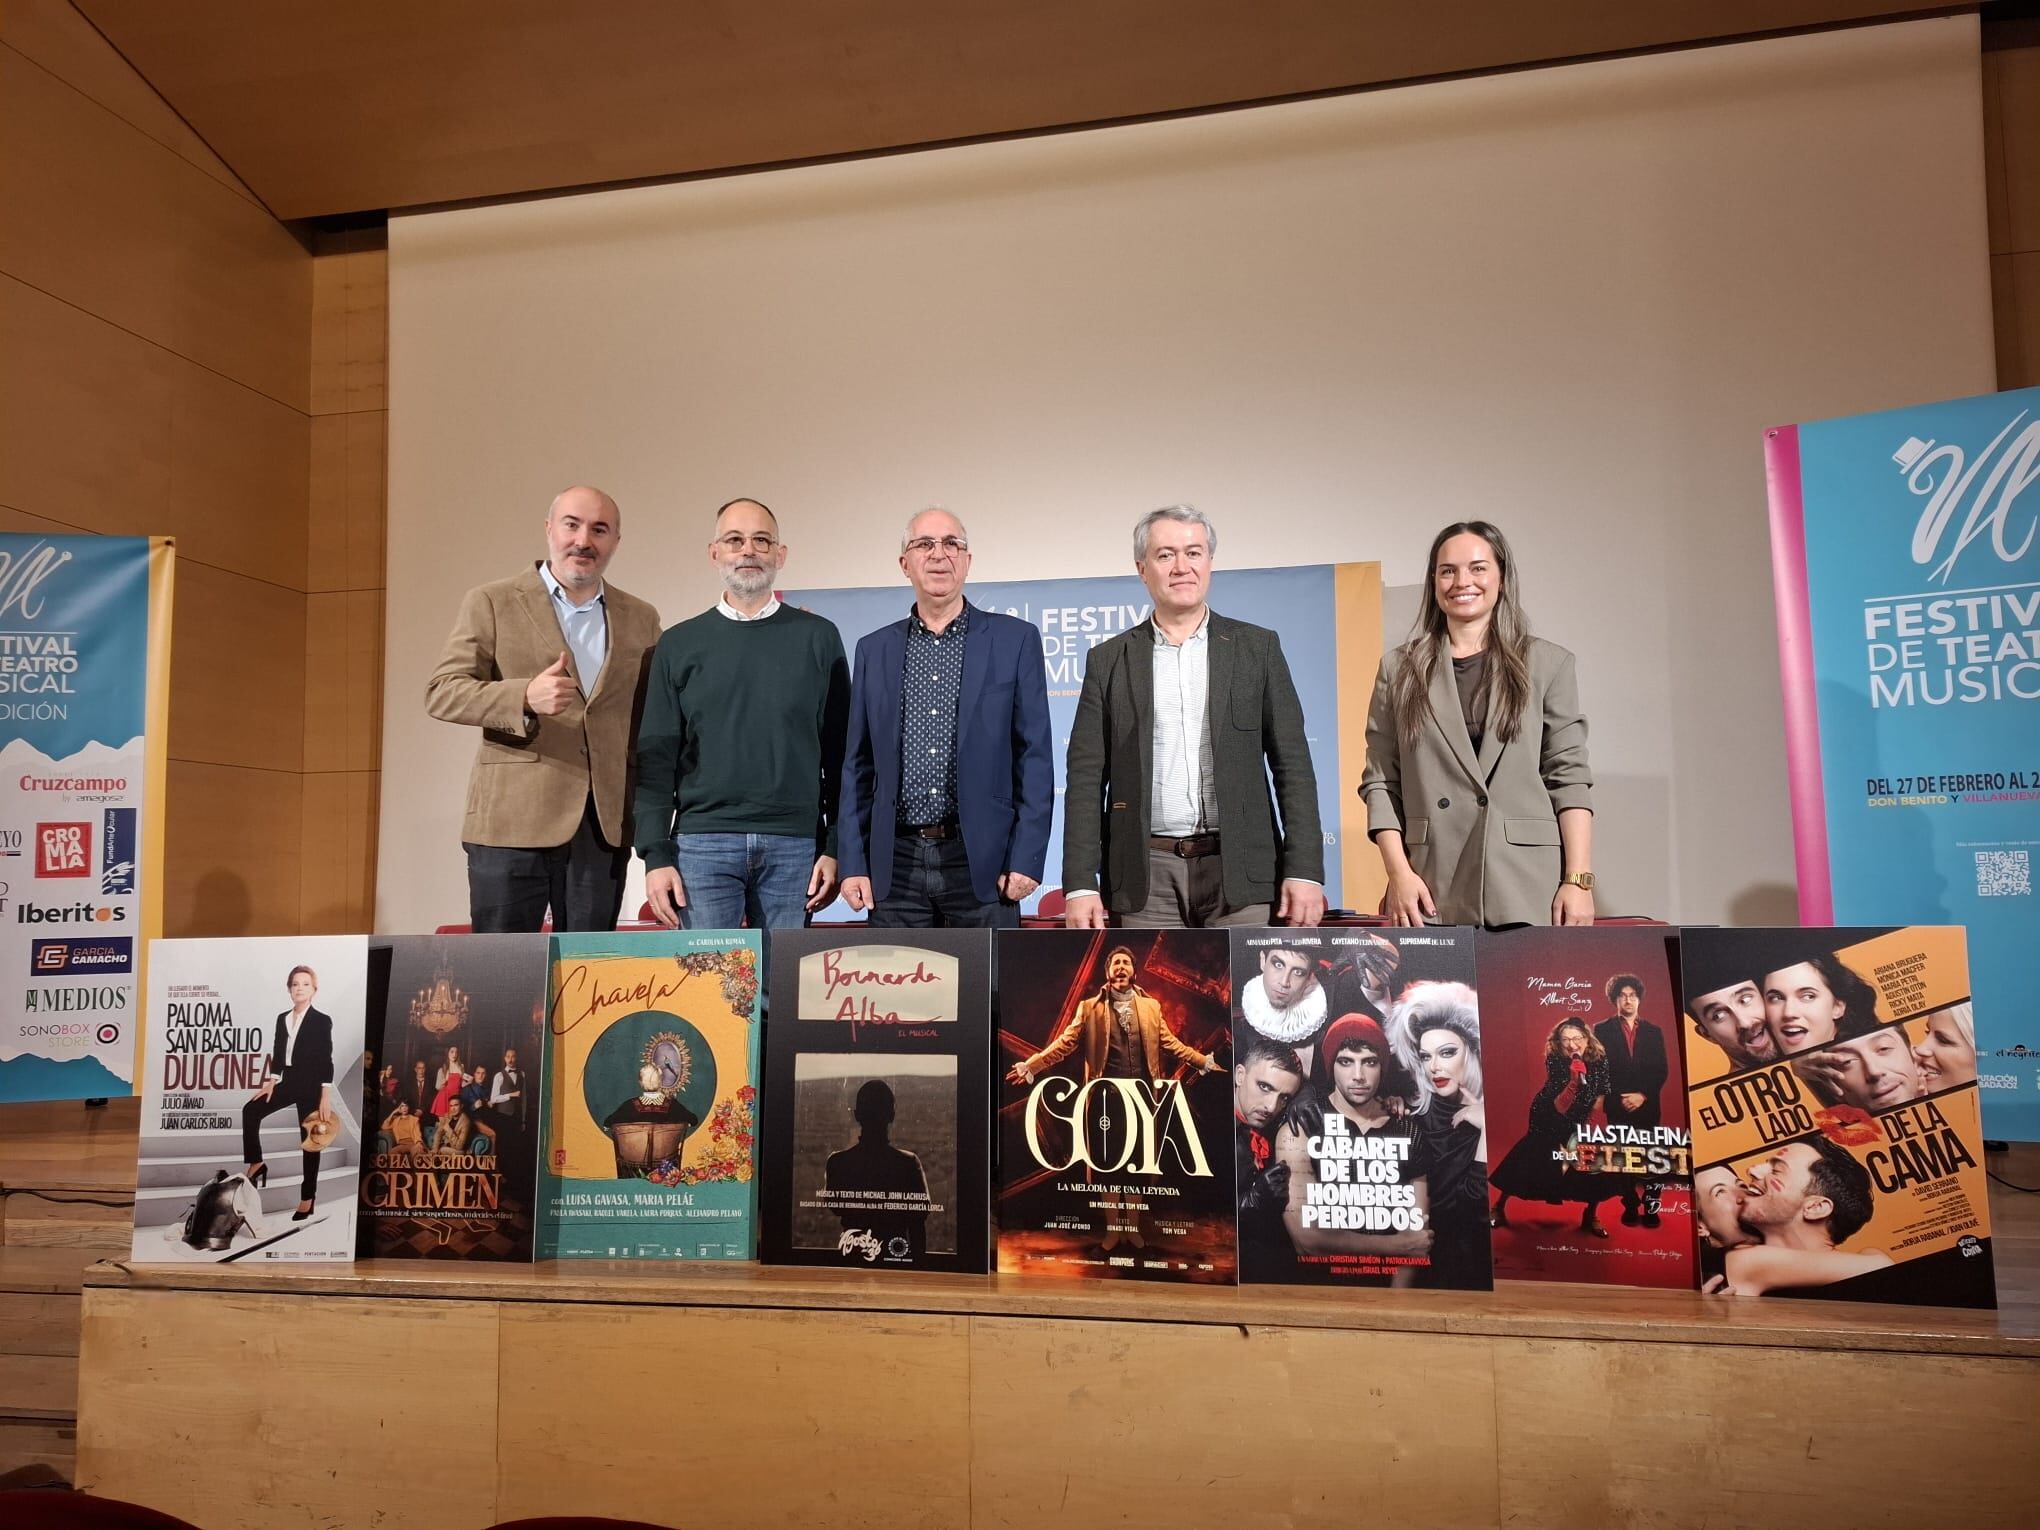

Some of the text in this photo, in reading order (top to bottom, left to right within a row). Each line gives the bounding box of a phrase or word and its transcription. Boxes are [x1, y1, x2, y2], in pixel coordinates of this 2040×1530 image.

[1043, 635, 1077, 656] DE
[1868, 640, 1925, 671] DE
[0, 656, 78, 673] EATRO
[1870, 662, 2040, 709] MUSIC
[20, 775, 127, 793] Cruzcampo
[1867, 778, 1894, 796] DEL
[1896, 777, 1913, 794] 27
[1917, 776, 1936, 793] DE
[1940, 772, 2005, 792] FEBRERO
[2009, 772, 2028, 790] AL
[1868, 794, 1959, 808] DON BENITO Y
[42, 826, 81, 844] CRO
[44, 840, 84, 858] MA
[46, 854, 86, 871] LIA
[18, 902, 126, 924] Iberitos
[72, 954, 128, 964] CAMACHO
[1874, 952, 1928, 976] ARIANA BRUGUERA
[823, 950, 941, 1000] Bernarda
[1527, 976, 1562, 991] Mamen
[1900, 974, 1918, 986] PETRI
[42, 986, 126, 1012] MEDIOS
[551, 966, 690, 1035] Chavela
[1888, 992, 1924, 1008] RICKY MATA
[1911, 1000, 1926, 1011] OLAY
[167, 1002, 232, 1028] PALOMA
[836, 996, 942, 1042] Alba
[20, 1023, 90, 1036] SONOBOX
[166, 1027, 262, 1053] SAN BASILIO
[48, 1036, 89, 1048] STORE
[1996, 1049, 2004, 1057] el
[164, 1054, 274, 1090] DULCINEA
[161, 1097, 204, 1109] JULIO AWAD
[1714, 1066, 1801, 1124] OTRO
[160, 1117, 232, 1130] JUAN CARLOS RUBIO
[1025, 1076, 1214, 1177] GOYA
[1324, 1113, 1350, 1136] EL
[1698, 1106, 1726, 1131] EL
[1754, 1104, 1814, 1144] LADO
[1880, 1110, 1918, 1143] DE
[1911, 1101, 1948, 1134] LA
[1577, 1123, 1640, 1144] HASTA
[1640, 1130, 1654, 1145] EL
[1307, 1137, 1411, 1160] CABARET
[1552, 1144, 1689, 1175] DE LA FIEST
[414, 1153, 474, 1170] ESCRITO
[476, 1155, 496, 1170] UN
[1320, 1159, 1400, 1183] DE LOS
[1866, 1128, 1978, 1194] CAMA
[361, 1171, 502, 1209] CRIMEN
[856, 1191, 862, 1199] DE
[863, 1191, 887, 1199] MICHAEL
[888, 1192, 902, 1200] JOHN
[1057, 1183, 1180, 1196] LA MELODÍA DE UNA LEYENDA
[1307, 1183, 1416, 1208] HOMBRES
[1915, 1177, 1959, 1196] DAVID SERRANO
[566, 1194, 592, 1205] LUISA
[594, 1194, 631, 1206] GAVASA,
[666, 1192, 695, 1206] PELÁE
[884, 1202, 908, 1210] FEDERICO
[928, 1203, 944, 1211] LORCA
[1302, 1205, 1424, 1231] PERDIDOS
[1903, 1236, 1921, 1248] BORJA
[1920, 1229, 1946, 1242] RABANAL
[1950, 1224, 1964, 1234] JOAN
